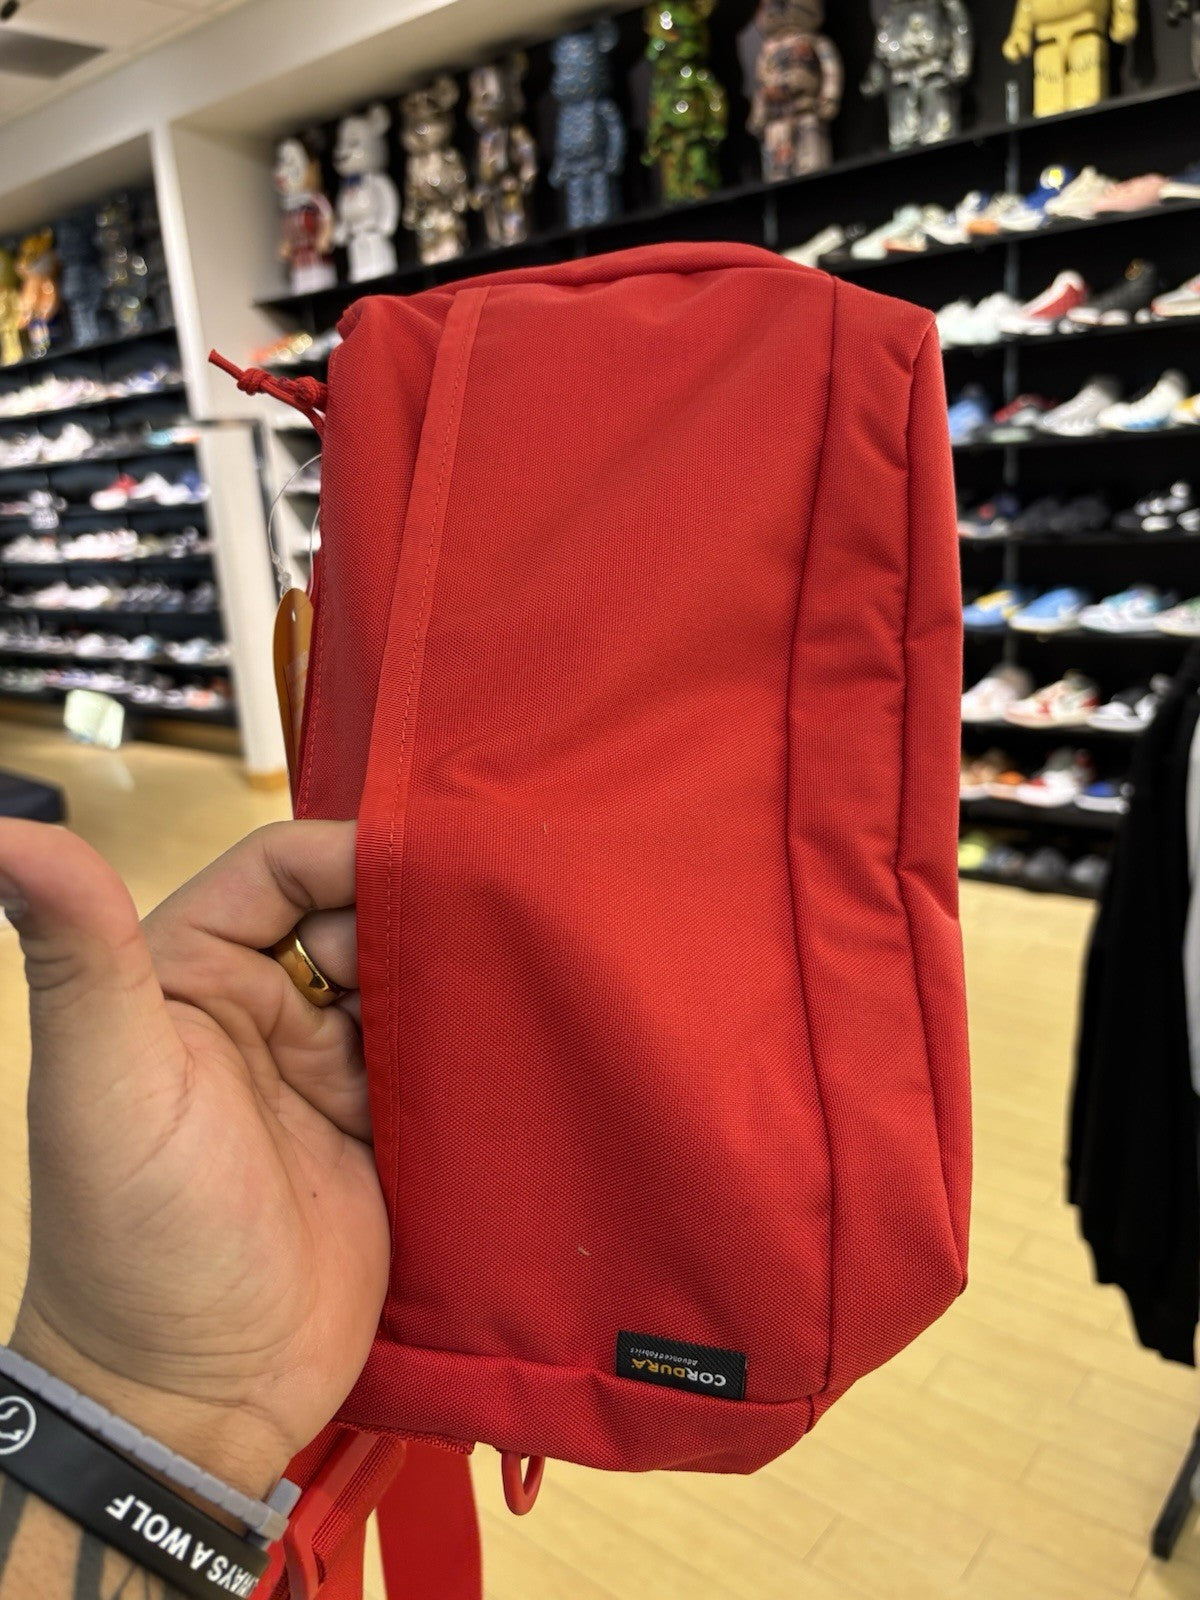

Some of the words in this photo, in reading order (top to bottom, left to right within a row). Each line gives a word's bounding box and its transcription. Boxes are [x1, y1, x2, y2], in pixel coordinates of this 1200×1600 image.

[632, 1358, 727, 1387] CORDURA
[104, 1494, 192, 1561] WOLF
[190, 1541, 215, 1570] A
